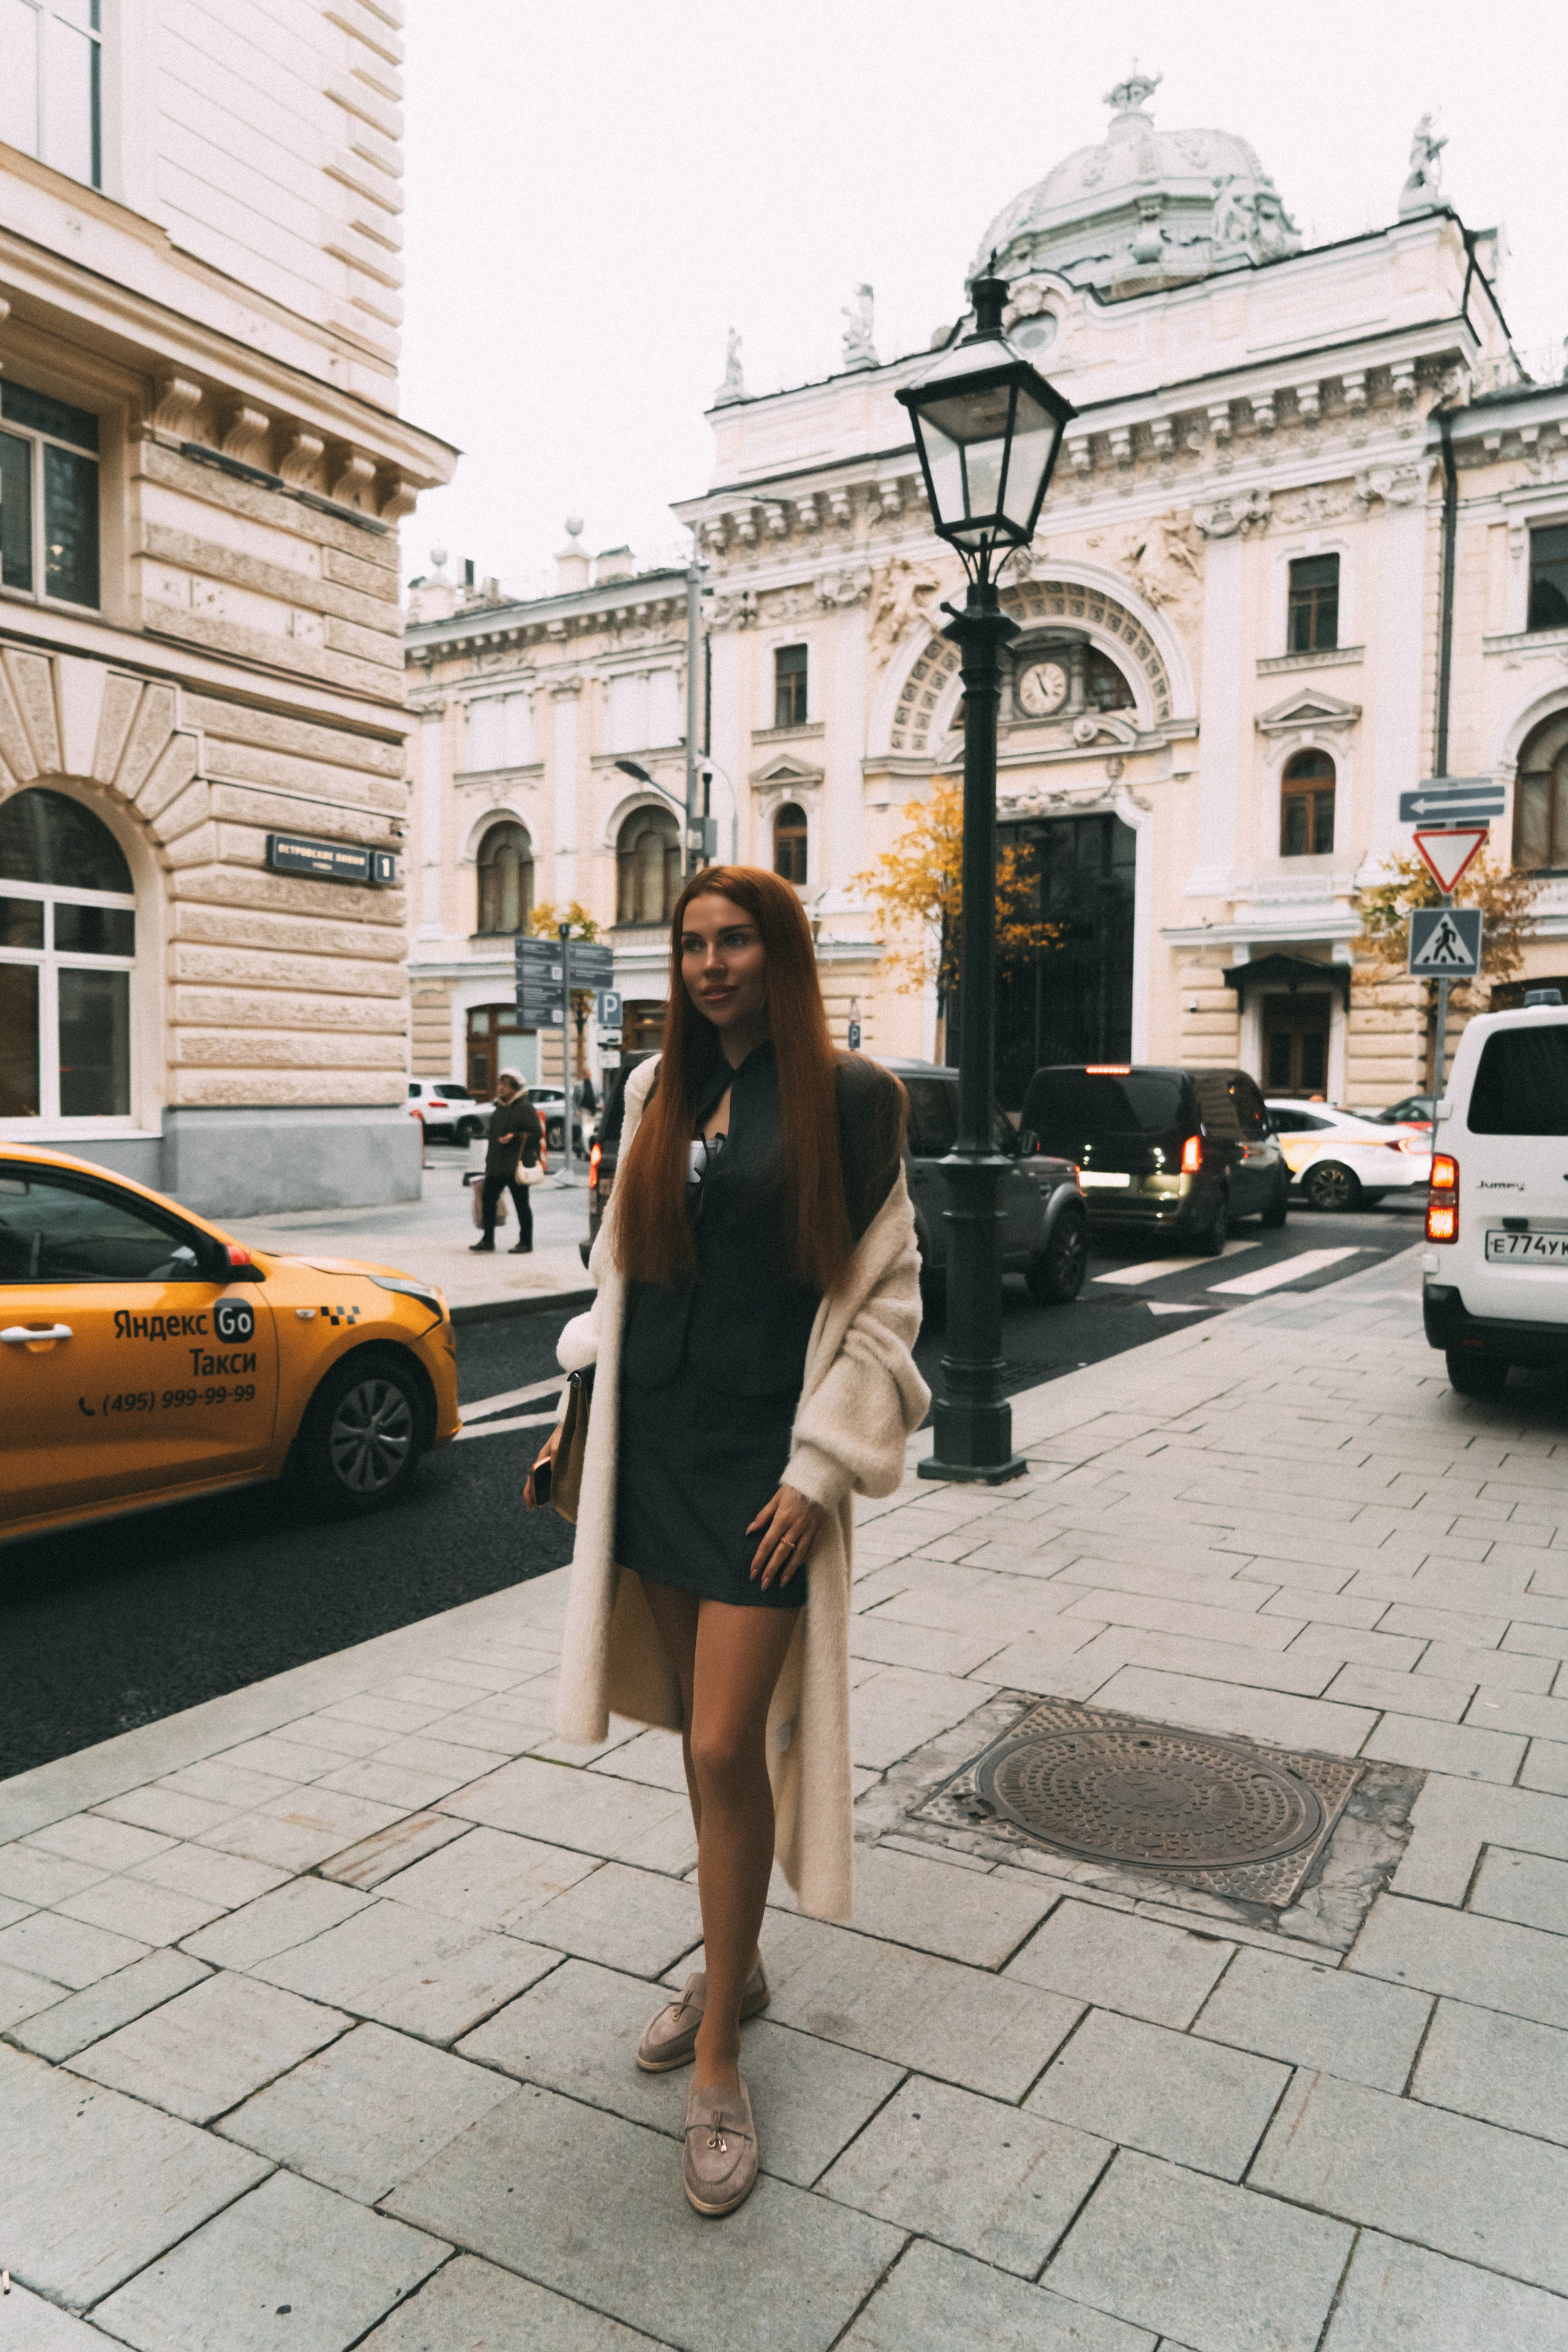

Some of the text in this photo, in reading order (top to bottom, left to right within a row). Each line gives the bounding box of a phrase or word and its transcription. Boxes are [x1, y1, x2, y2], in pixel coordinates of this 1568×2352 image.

[382, 858, 390, 878] 1
[603, 994, 618, 1022] P
[114, 1308, 252, 1341] Яндекс Go
[189, 1348, 257, 1377] Такси
[102, 1384, 256, 1416] (495) 999-99-99
